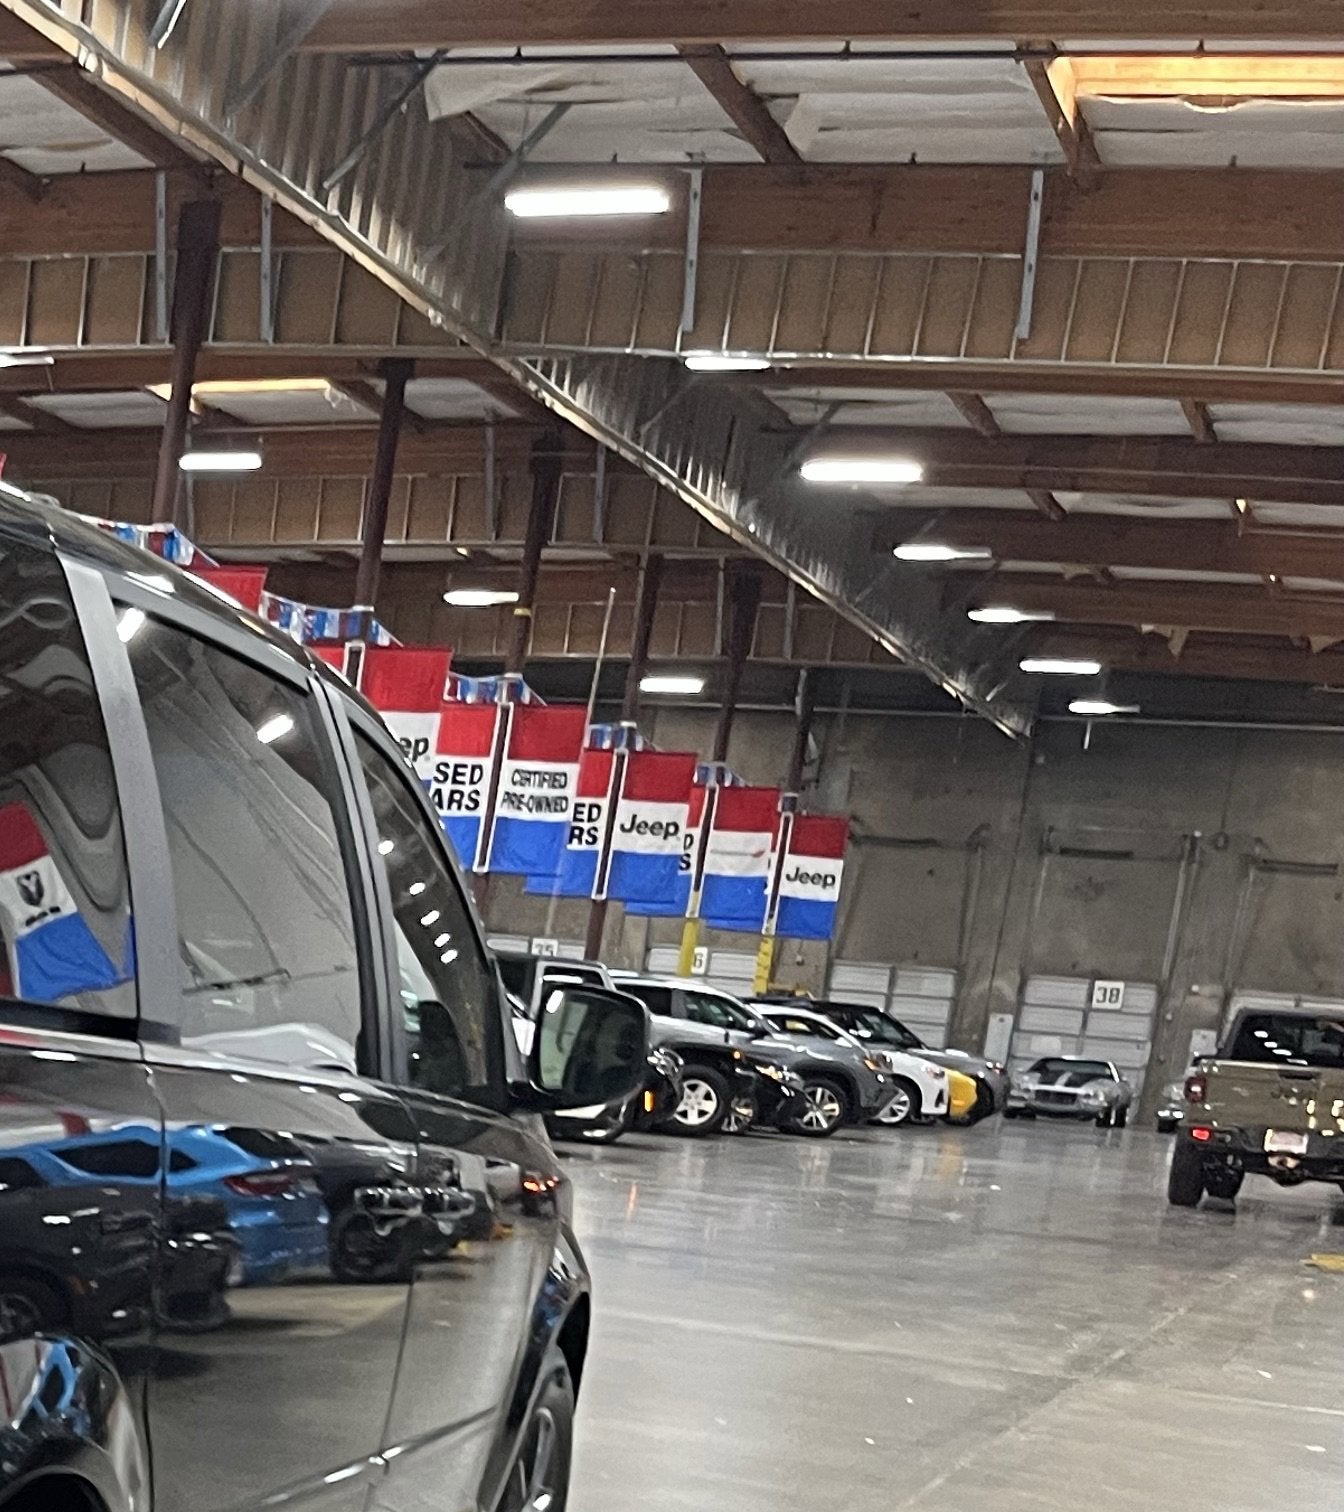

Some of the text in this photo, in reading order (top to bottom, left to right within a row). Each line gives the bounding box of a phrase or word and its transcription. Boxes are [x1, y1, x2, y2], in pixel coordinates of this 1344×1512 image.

[399, 736, 430, 762] ep
[433, 762, 484, 784] SED
[511, 768, 568, 789] CERTIFIED
[431, 789, 481, 811] ARS
[501, 791, 569, 813] PRE-OWNED
[572, 803, 602, 823] ED
[568, 826, 599, 846] RS
[619, 814, 680, 841] Jeep
[785, 867, 836, 889] Jeep
[1095, 986, 1121, 1004] 38
